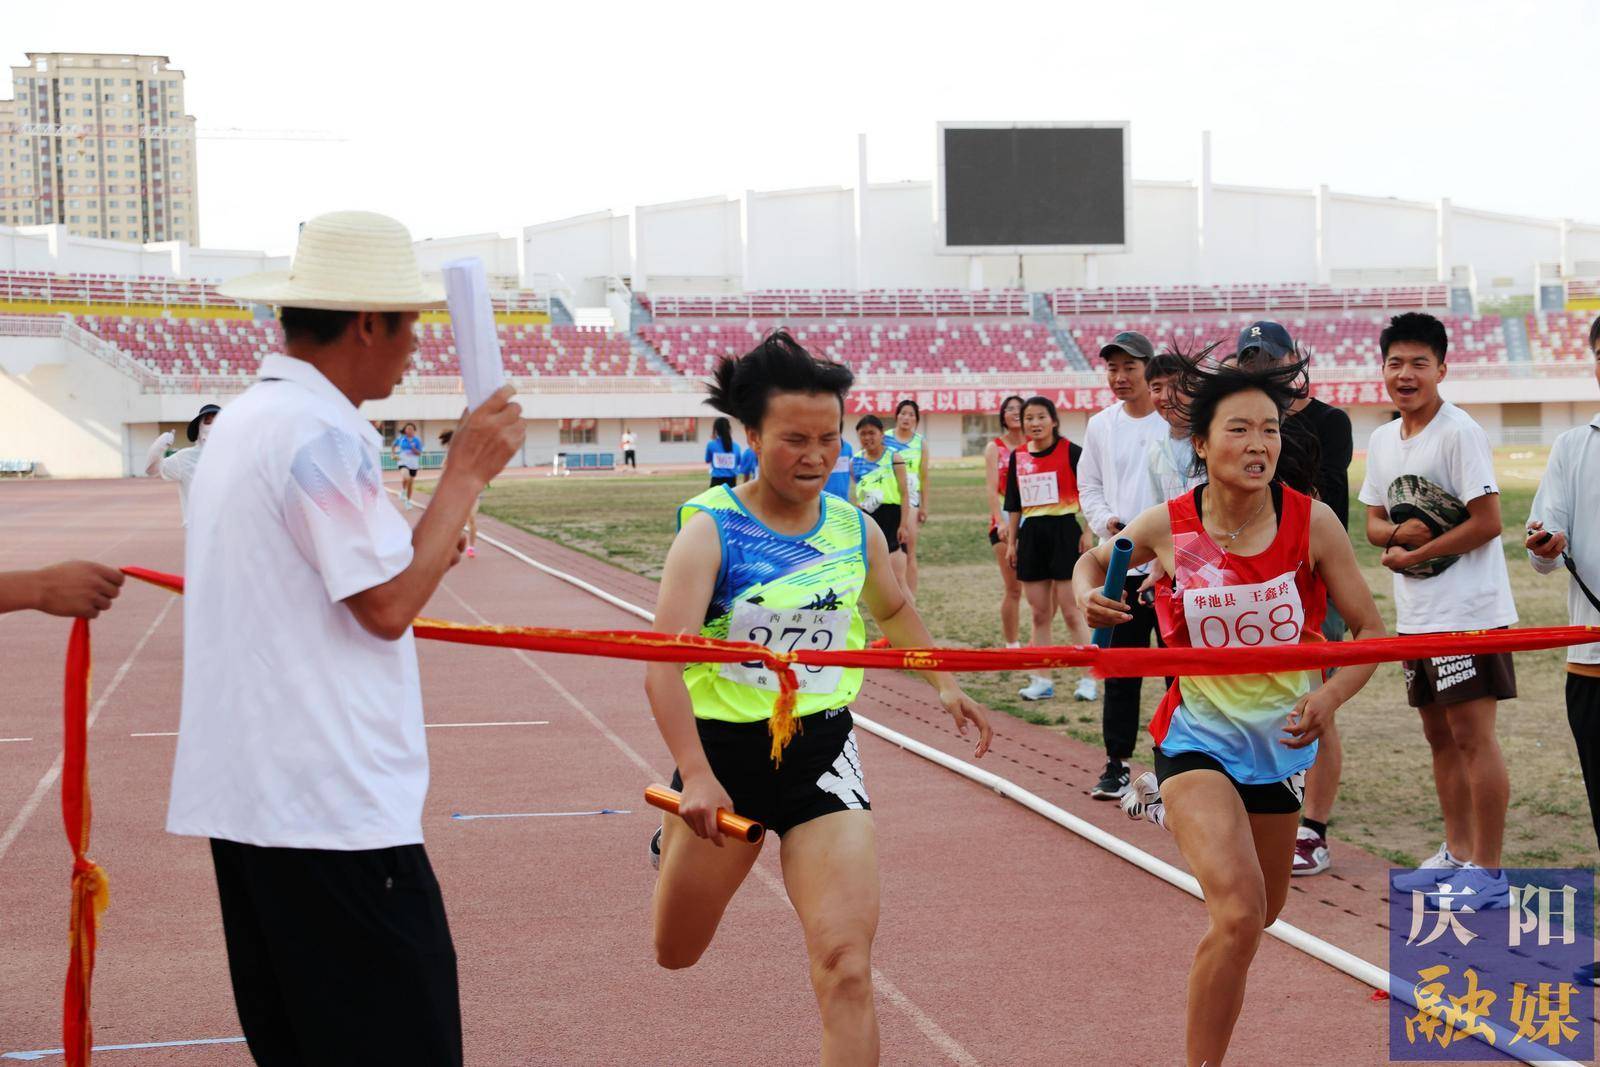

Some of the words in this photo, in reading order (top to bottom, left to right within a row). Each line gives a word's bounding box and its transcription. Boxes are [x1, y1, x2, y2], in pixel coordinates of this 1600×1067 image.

[1194, 592, 1237, 609] 华池县
[1200, 603, 1299, 648] 068
[1438, 658, 1473, 677] KNOW
